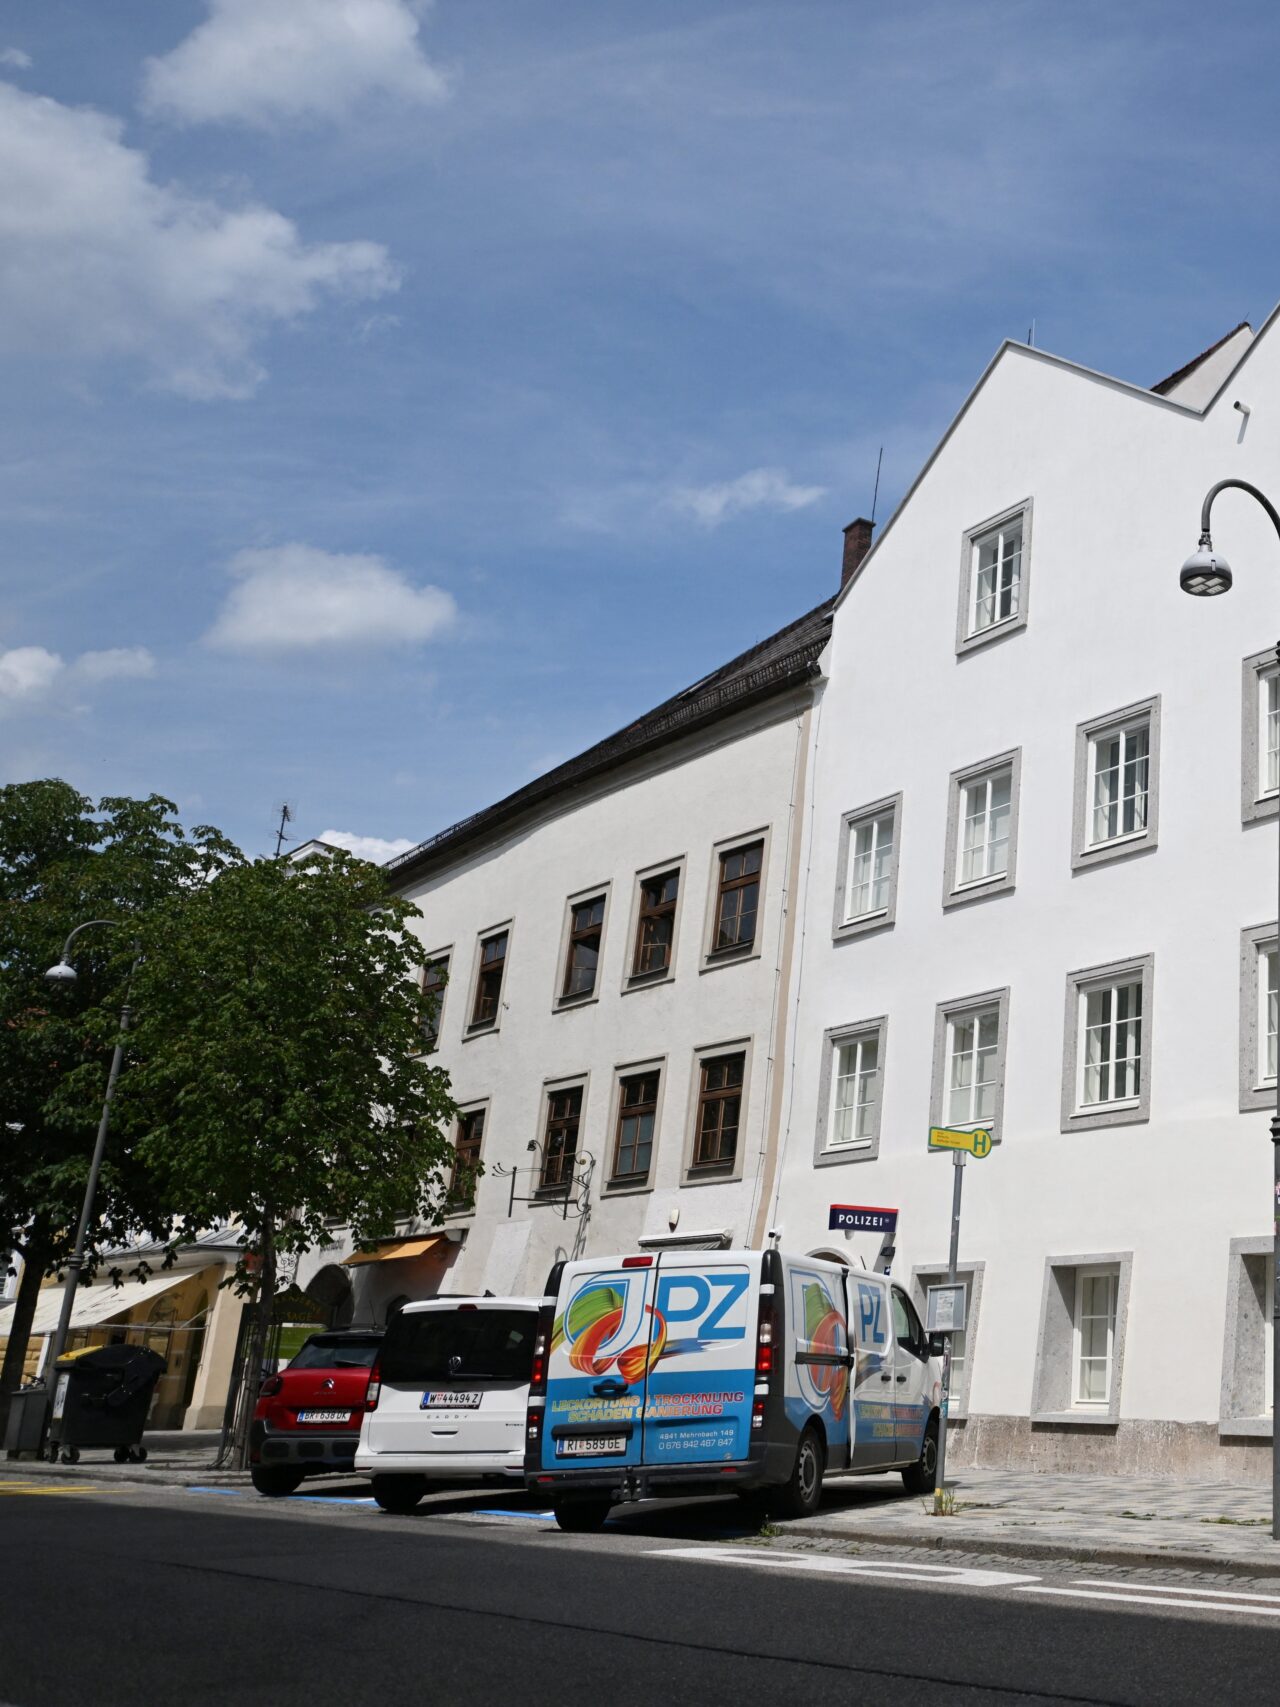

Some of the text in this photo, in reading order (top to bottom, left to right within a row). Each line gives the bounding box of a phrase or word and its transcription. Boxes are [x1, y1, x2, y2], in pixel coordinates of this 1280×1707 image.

[973, 1133, 987, 1153] H
[838, 1214, 883, 1227] POLIZEI
[654, 1391, 745, 1405] TROCKNUNG
[568, 1403, 723, 1423] SCHADEN SANIERUNG
